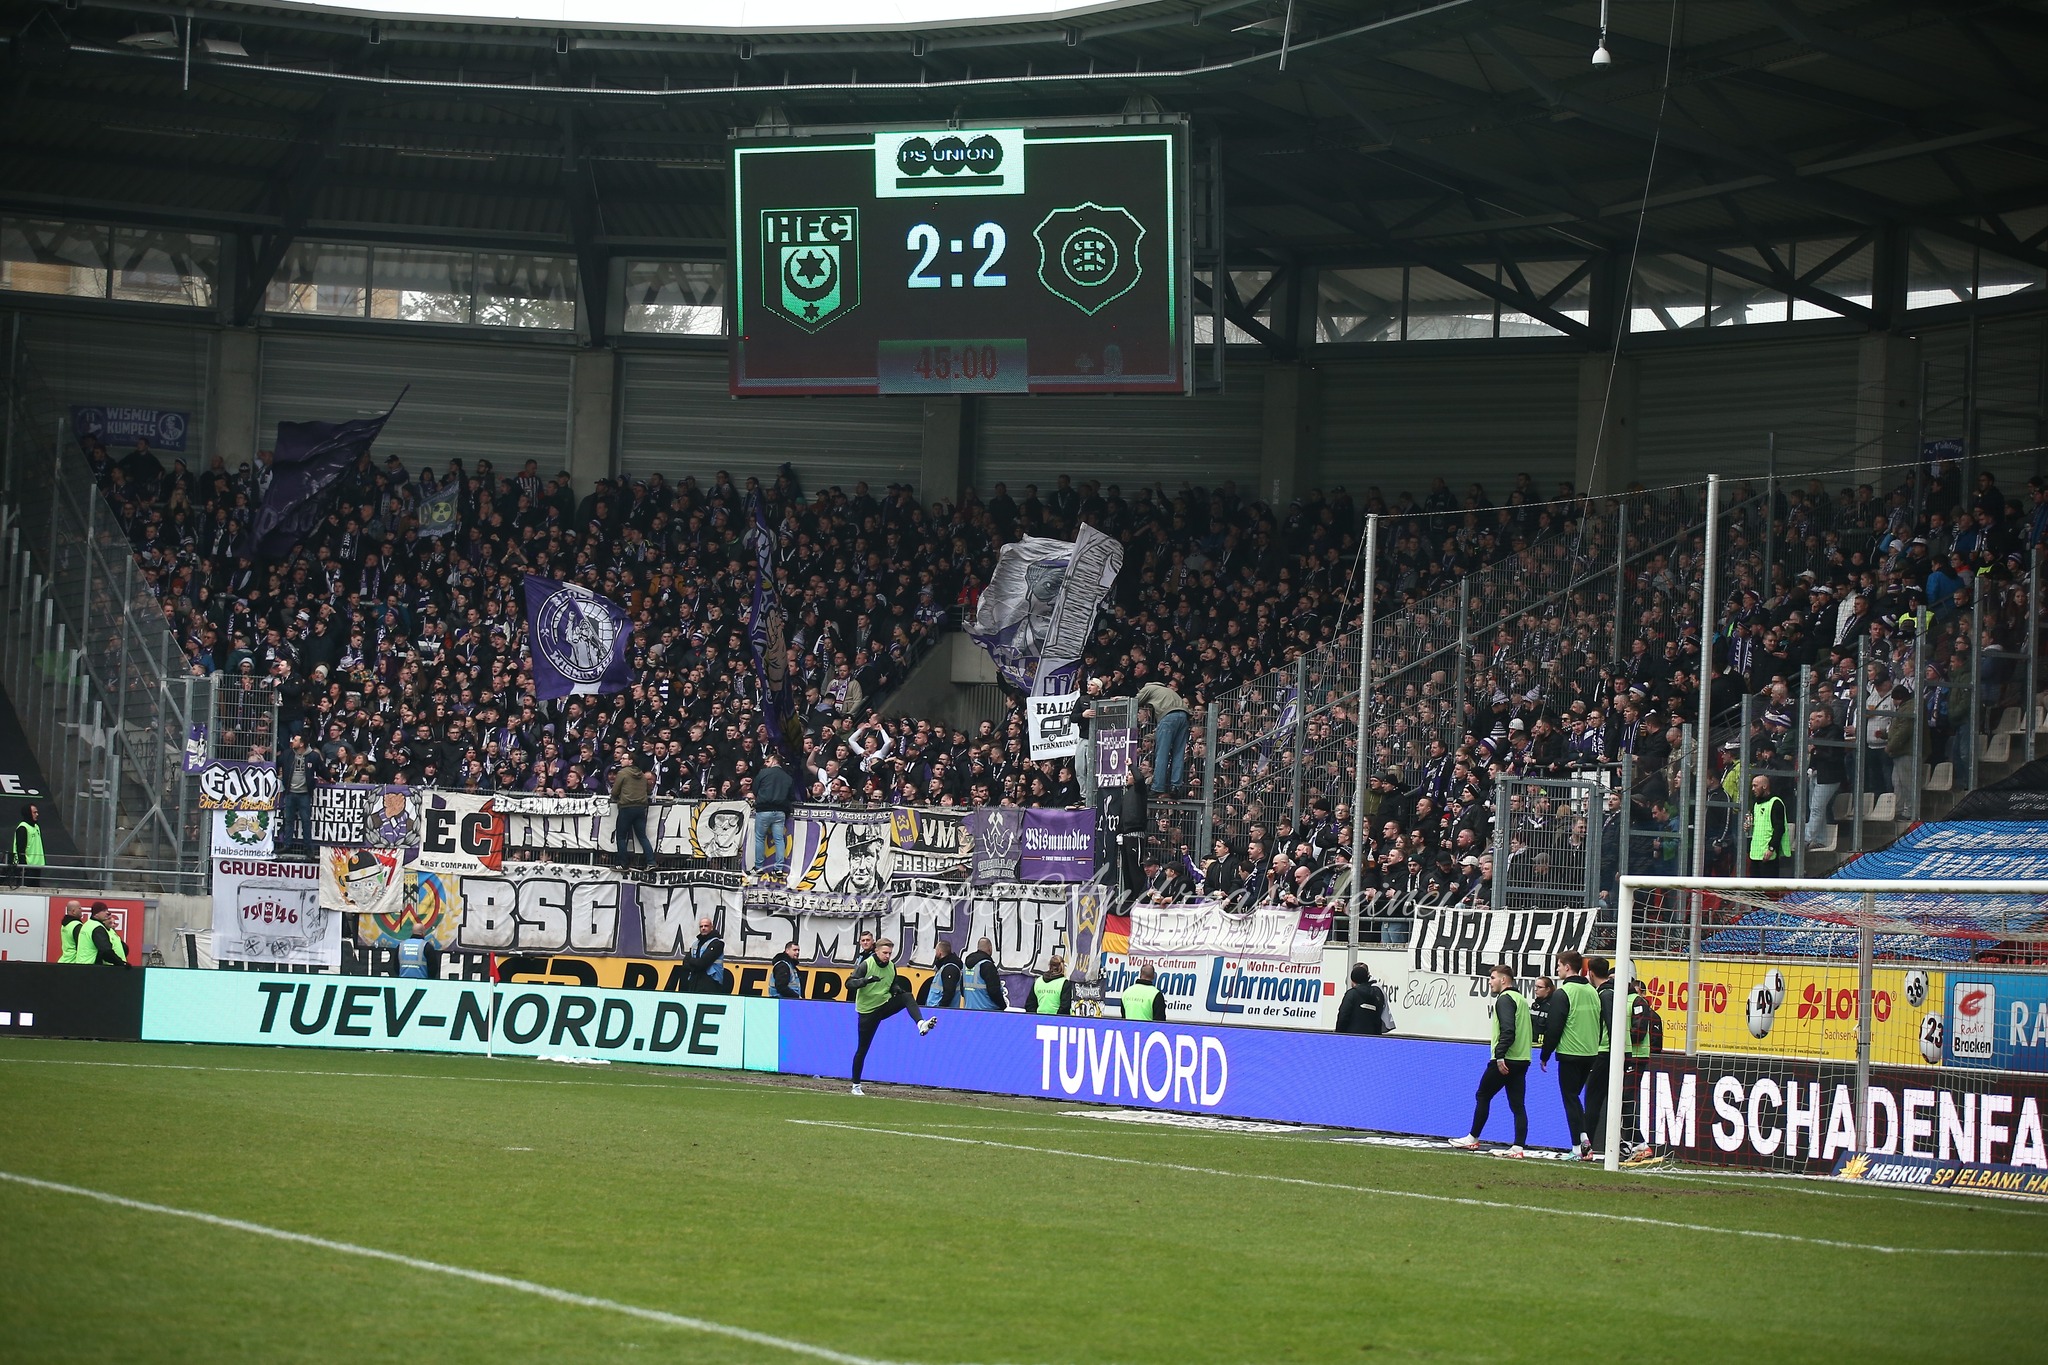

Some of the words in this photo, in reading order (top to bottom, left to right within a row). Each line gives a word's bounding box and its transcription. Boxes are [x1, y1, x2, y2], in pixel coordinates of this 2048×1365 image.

[933, 148, 994, 161] UNION
[907, 221, 1007, 289] 2:2
[106, 407, 158, 422] WISMUT
[107, 421, 156, 437] KUMPELS
[1032, 739, 1079, 752] INTERNATIONA
[423, 809, 492, 856] EC
[1026, 828, 1091, 851] Wismutadler
[420, 859, 439, 868] EAST
[441, 861, 478, 870] COMPANY
[458, 876, 621, 952] BSG
[1415, 910, 1588, 977] THALHEIM
[1247, 961, 1321, 974] Wohn-Centrum
[1206, 956, 1322, 1013] Lührmann
[1403, 980, 1432, 1010] Edel
[1430, 977, 1457, 1009] Pils
[1667, 980, 1728, 1014] LOTO
[1756, 990, 1773, 1014] 49
[257, 981, 728, 1056] TUEV-NORD.DE
[1262, 1006, 1279, 1015] der
[1282, 1008, 1317, 1018] Saline
[1961, 1024, 1985, 1036] Radio
[1953, 1037, 1991, 1054] Brocken
[1867, 1163, 1932, 1184] MERKUR
